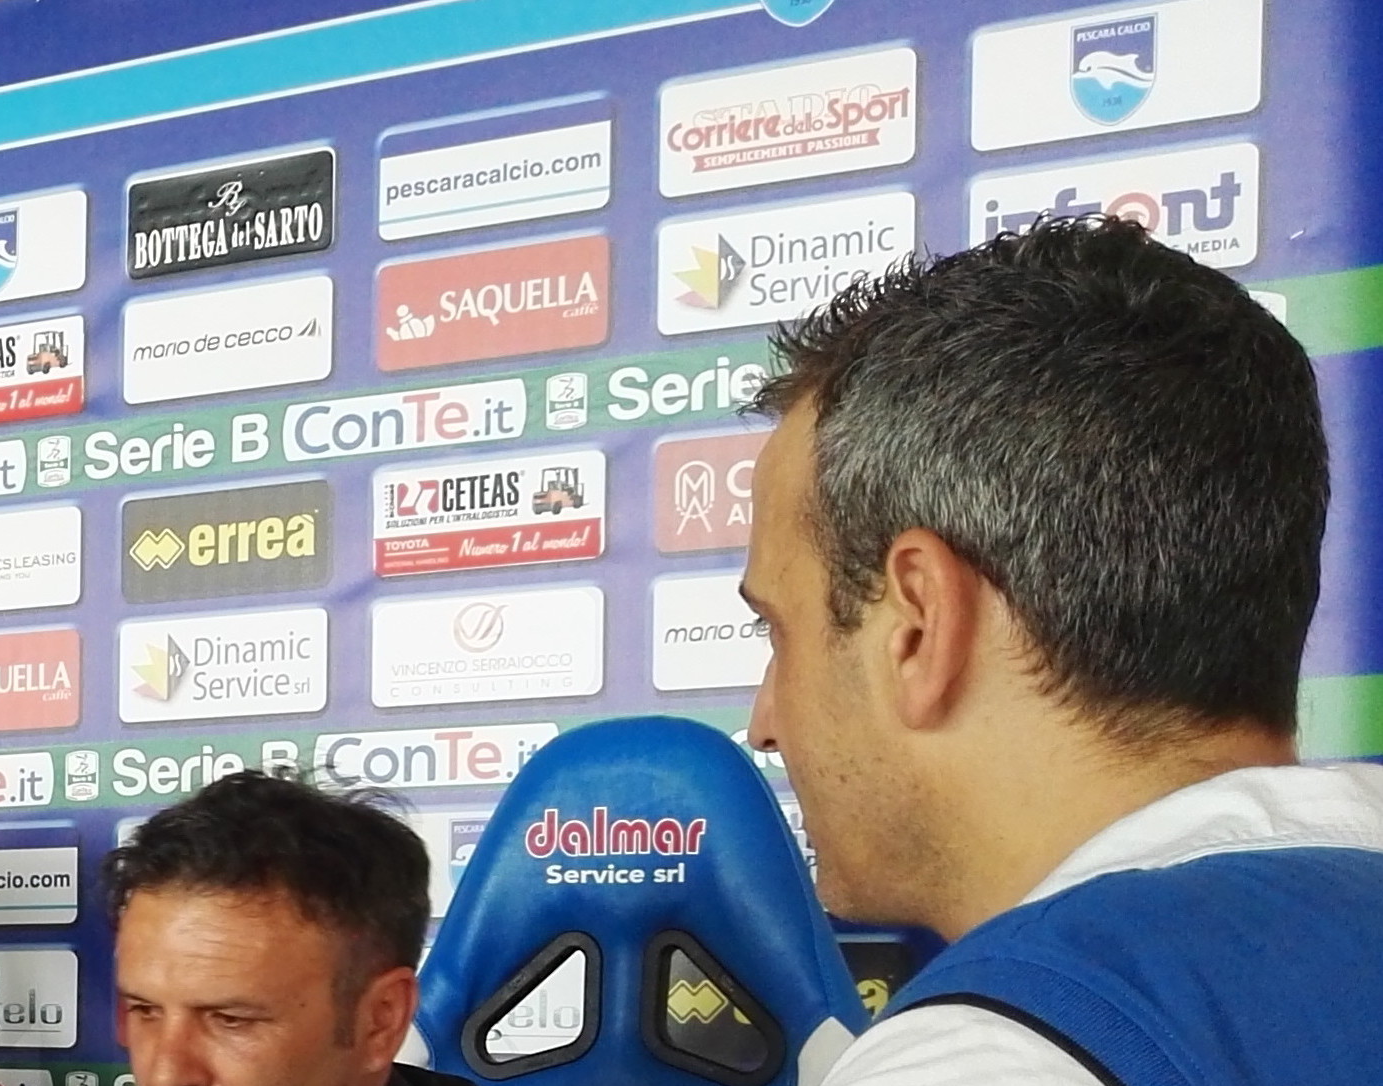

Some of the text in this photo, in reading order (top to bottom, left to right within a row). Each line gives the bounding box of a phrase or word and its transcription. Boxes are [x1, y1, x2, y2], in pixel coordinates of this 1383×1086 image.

[667, 87, 910, 153] Corriere dello Sport
[703, 131, 868, 169] SEMPLICEMENTE PASSIONE
[386, 150, 602, 205] pescaracalcio.com
[134, 202, 324, 269] BOTTEGA del SARTO
[751, 221, 895, 268] Dinamic
[440, 271, 598, 325] SAQUELLA
[133, 325, 293, 363] mario de cecco
[9, 389, 19, 410] 1
[608, 357, 767, 421] Serie
[84, 392, 515, 480] Serie B ConTe.it
[442, 471, 520, 512] CETEAS
[13, 551, 77, 570] LEASING
[385, 538, 430, 552] TOYOTA
[511, 531, 523, 553] 1
[193, 631, 311, 667] Dinamic
[664, 624, 735, 644] mario
[192, 668, 312, 702] Service srl
[391, 653, 573, 679] VINCENZO SERRAIOCCO
[525, 807, 707, 859] dalmar
[545, 863, 686, 885] Service srl
